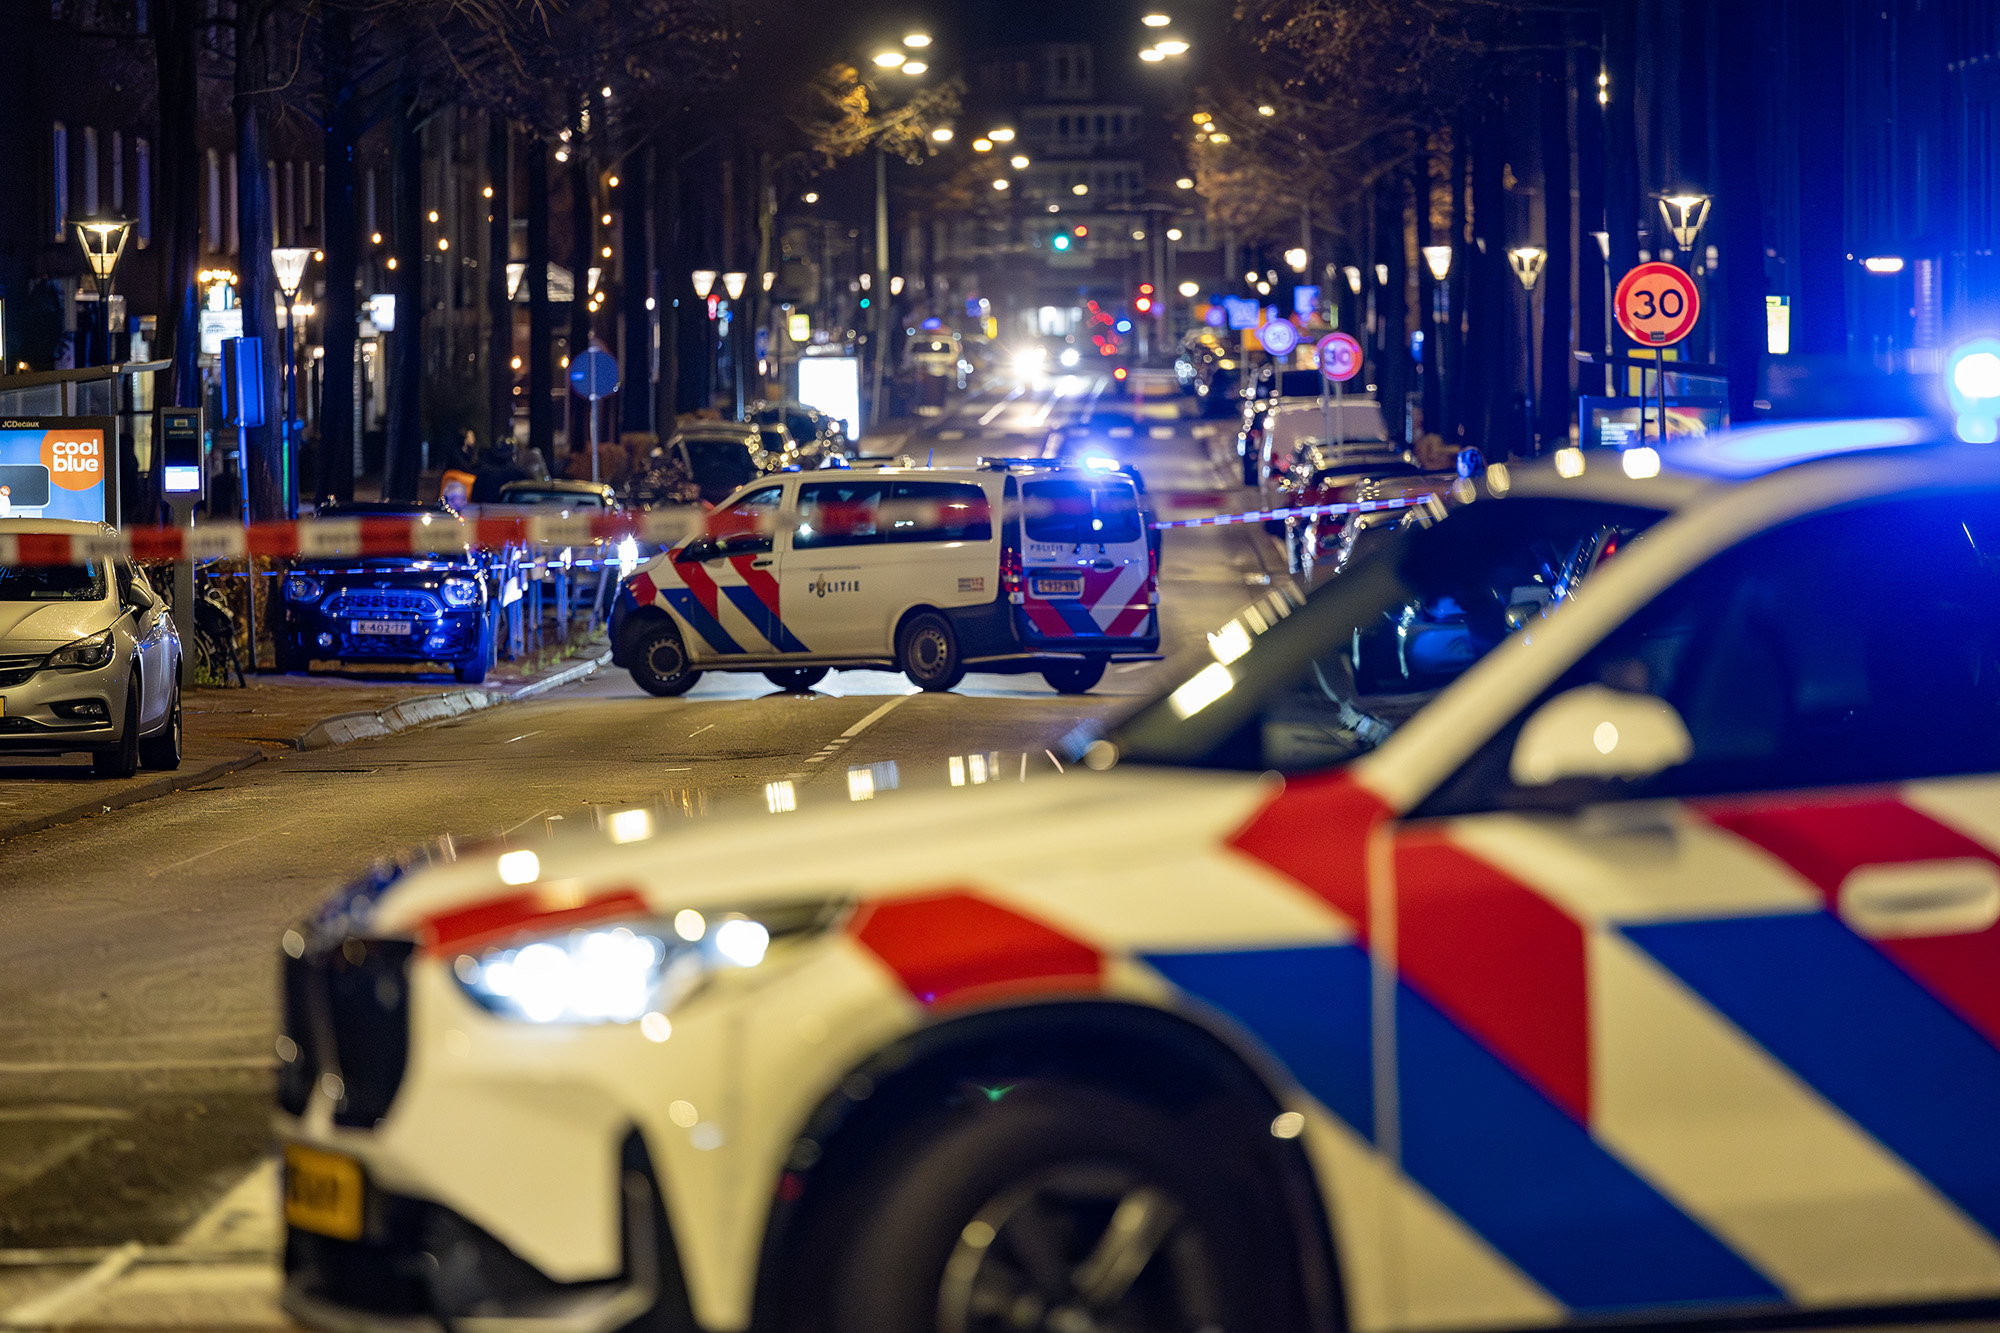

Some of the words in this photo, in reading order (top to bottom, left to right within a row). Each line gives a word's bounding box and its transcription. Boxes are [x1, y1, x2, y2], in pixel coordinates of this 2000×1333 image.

[1633, 289, 1684, 320] 30
[52, 438, 98, 455] cool
[53, 454, 99, 472] blue
[808, 580, 860, 599] POLITIE
